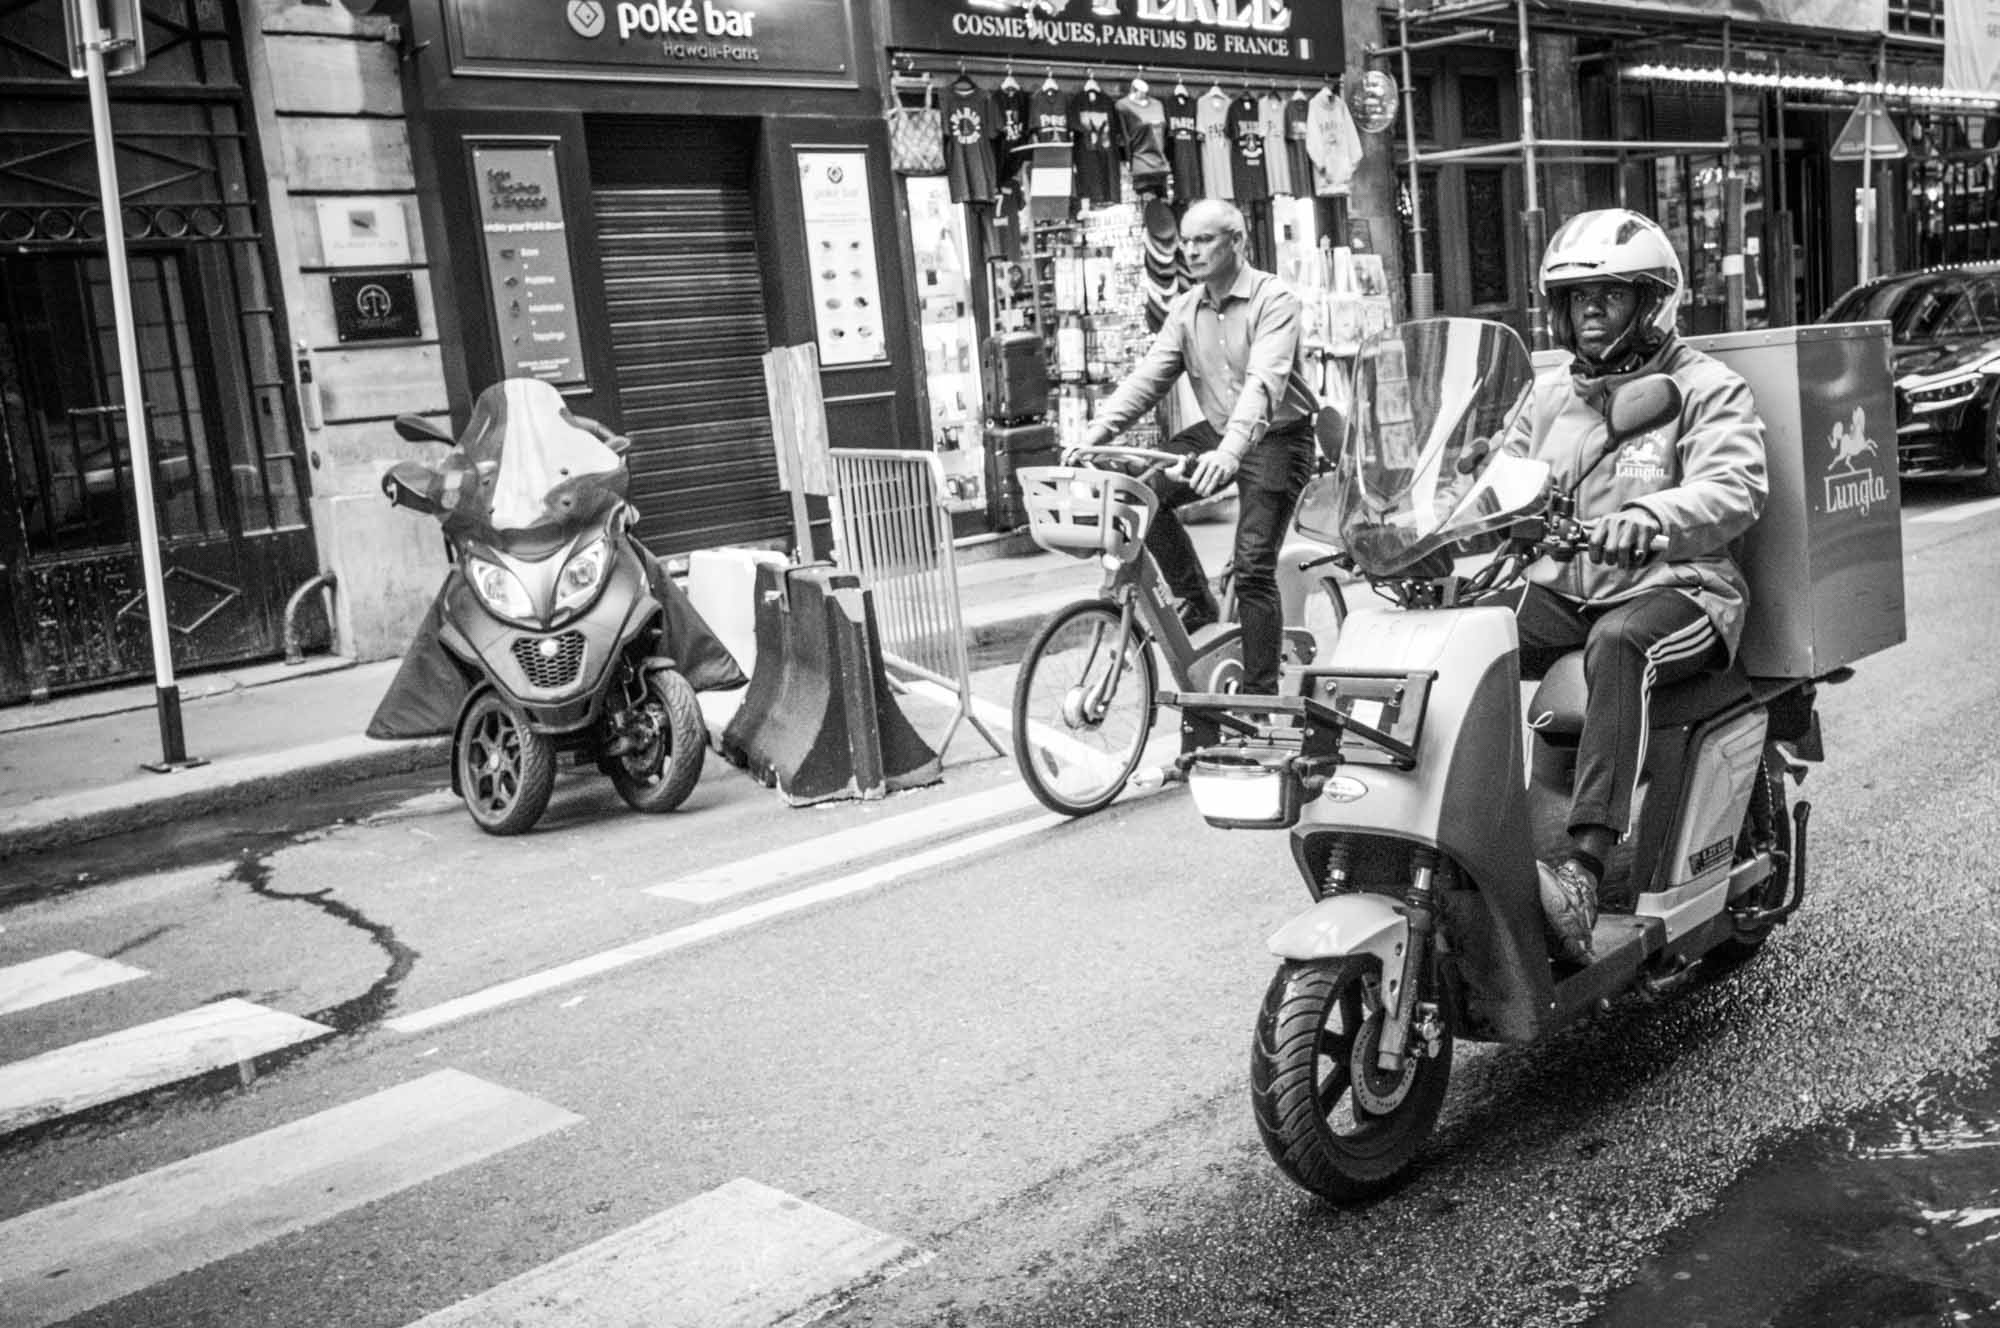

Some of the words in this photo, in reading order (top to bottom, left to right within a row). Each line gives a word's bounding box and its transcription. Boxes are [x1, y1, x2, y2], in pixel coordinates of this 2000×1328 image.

[617, 0, 698, 39] poké
[703, 0, 755, 36] bar
[1102, 24, 1187, 49] PARFUMS
[1194, 32, 1217, 51] DE
[1224, 34, 1289, 57] FRANCE
[1824, 468, 1887, 516] Lungta
